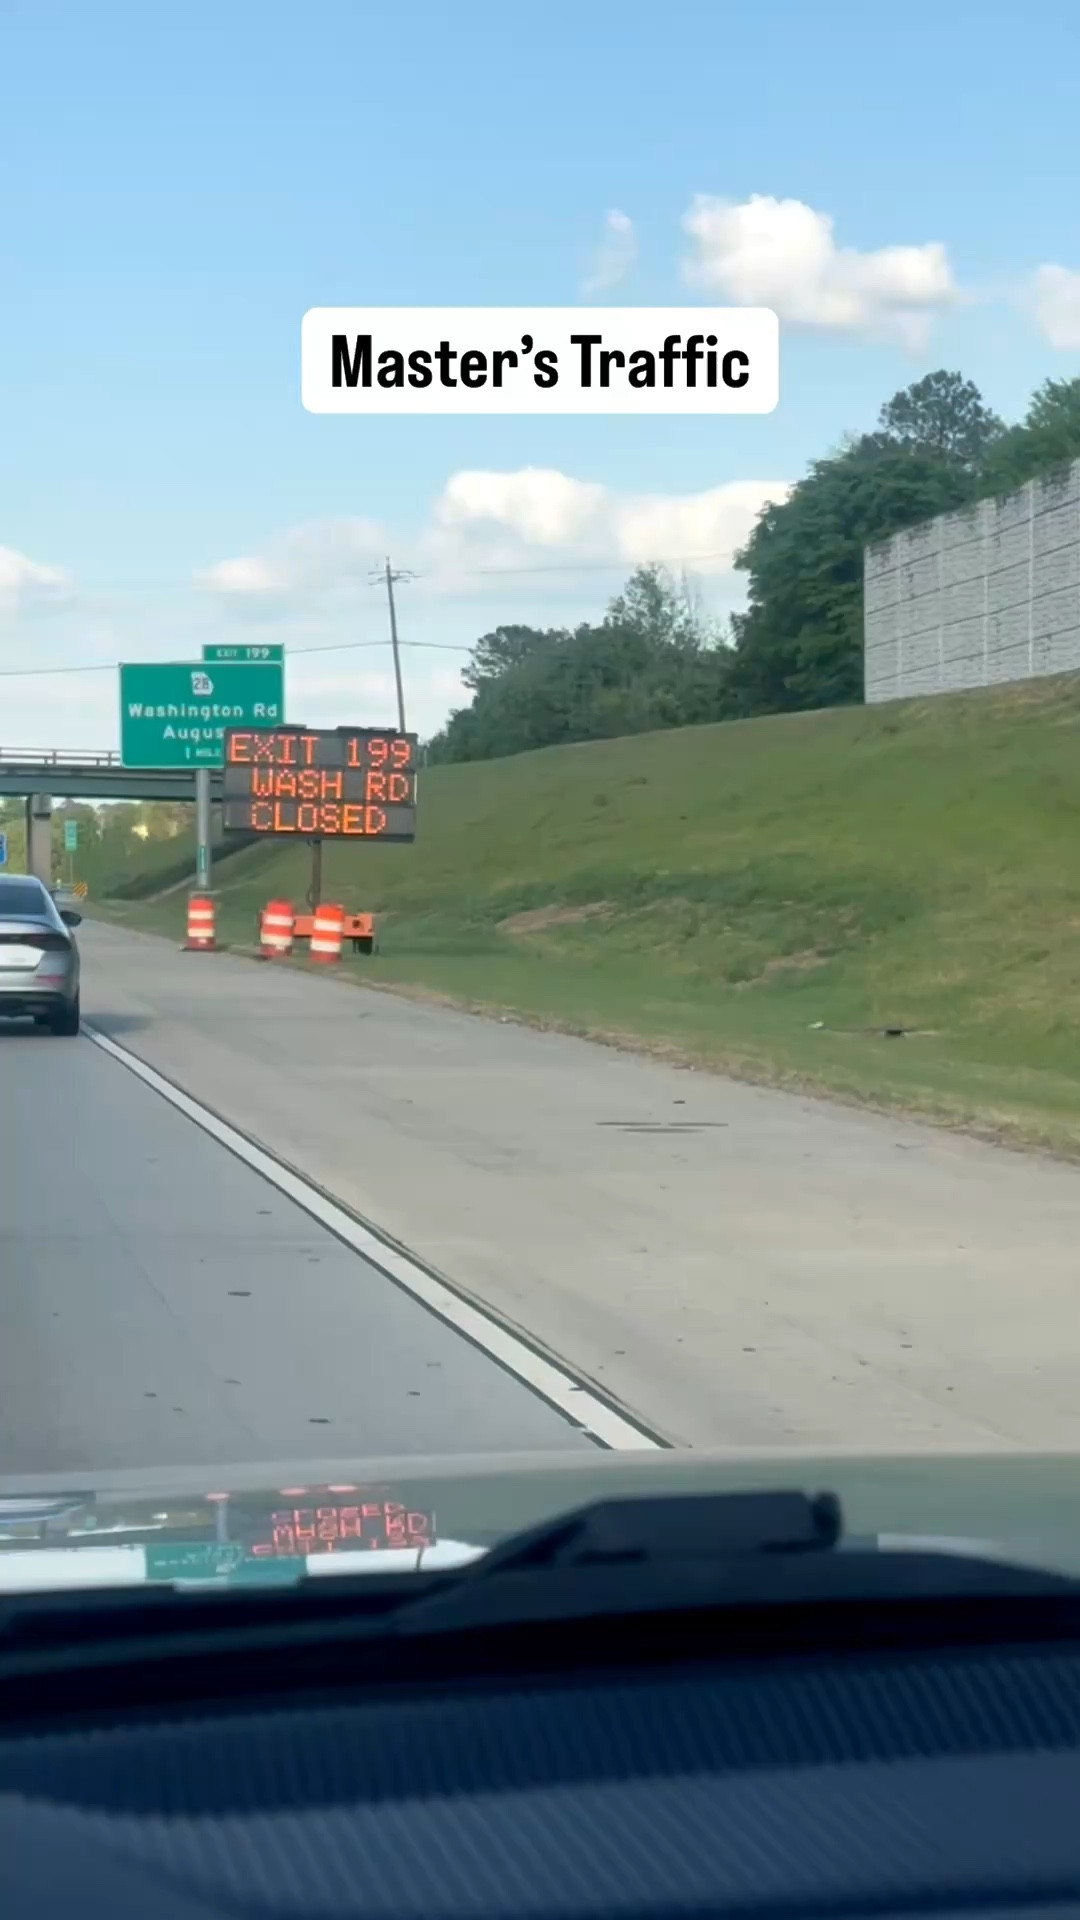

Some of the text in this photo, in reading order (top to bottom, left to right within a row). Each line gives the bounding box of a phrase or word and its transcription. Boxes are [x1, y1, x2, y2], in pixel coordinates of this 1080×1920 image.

[246, 647, 270, 659] 199
[193, 677, 209, 691] 28
[128, 703, 278, 721] Washington Rd
[230, 734, 411, 768] EXIT 199
[252, 767, 409, 801] WASH RD
[251, 802, 387, 834] CLOSED
